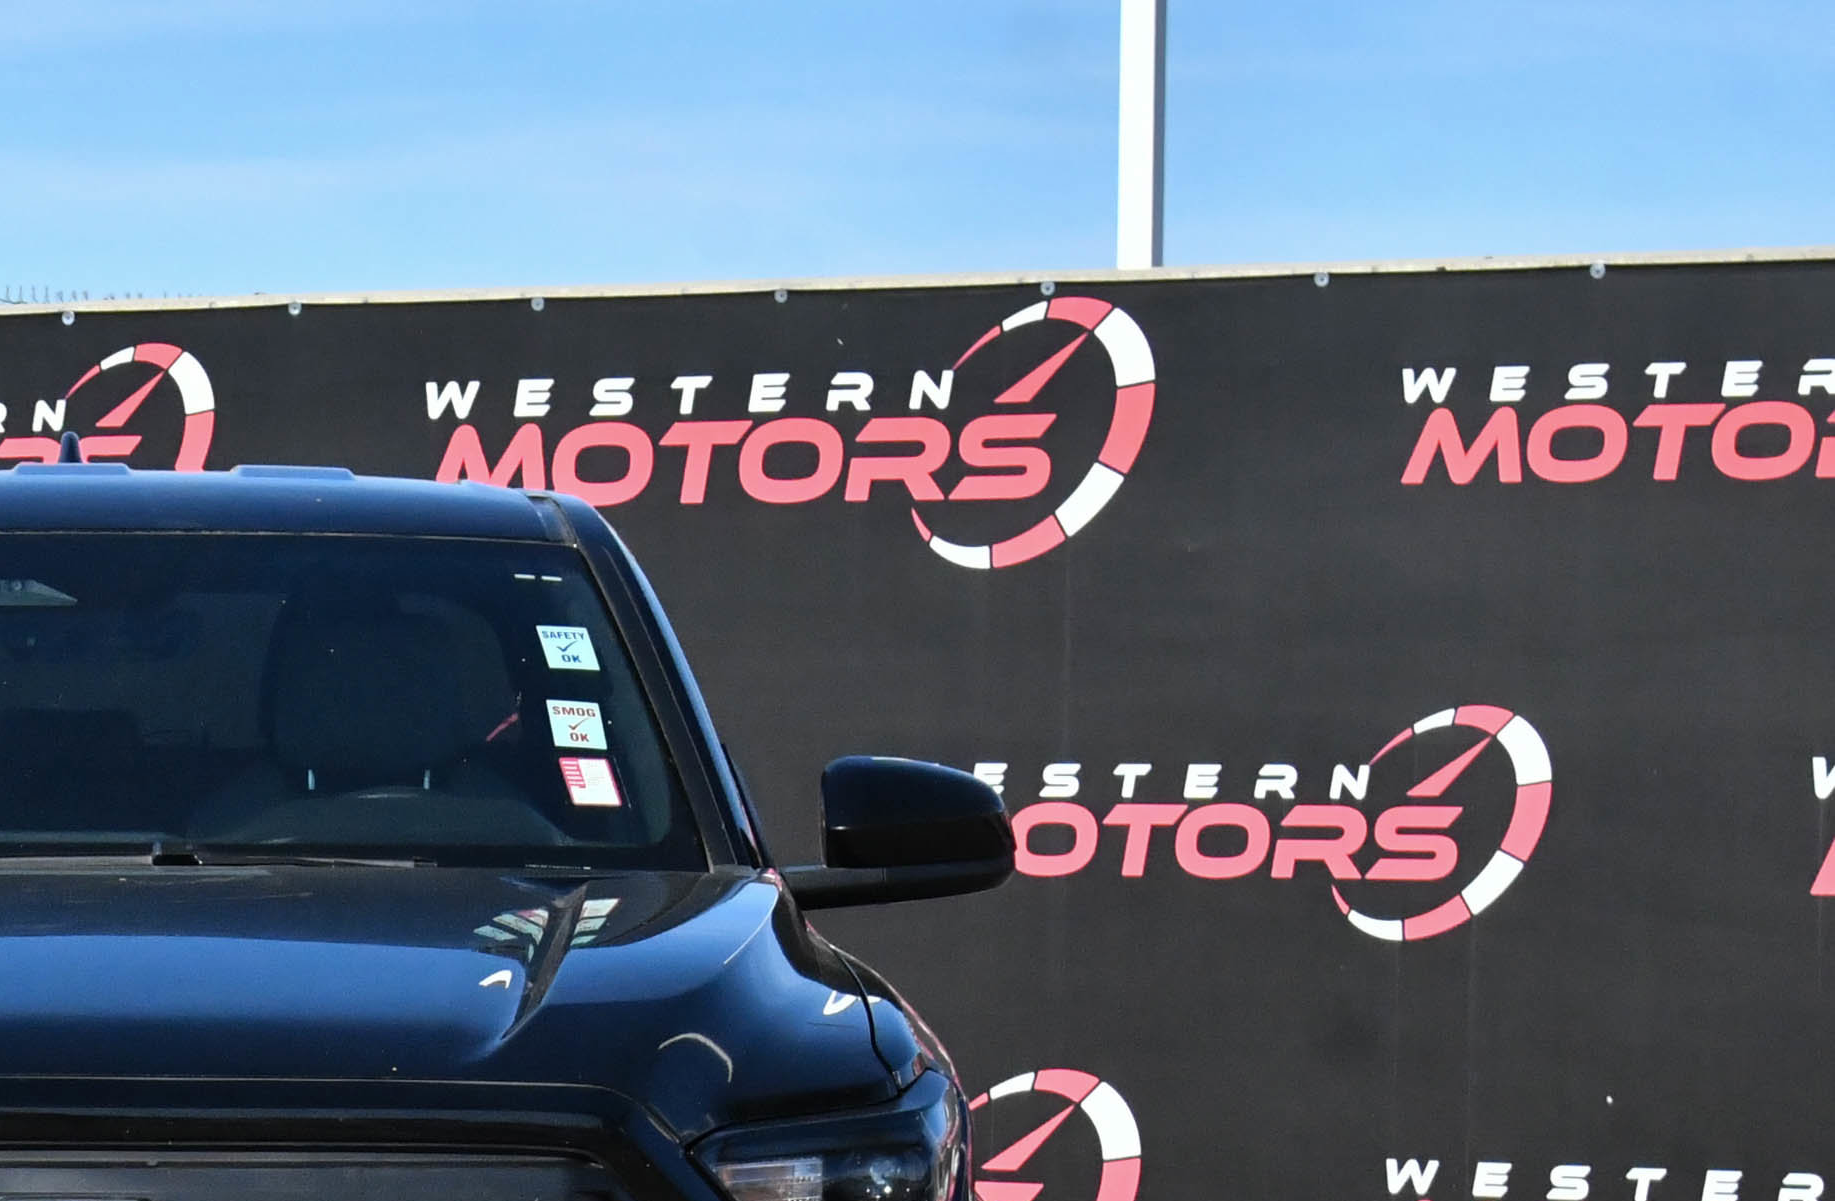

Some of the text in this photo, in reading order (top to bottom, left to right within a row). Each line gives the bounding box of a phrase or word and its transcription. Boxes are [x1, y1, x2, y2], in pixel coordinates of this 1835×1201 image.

[425, 370, 955, 420] WESTERN
[434, 413, 1057, 508] MOTORS
[1400, 401, 1835, 485] MOTO
[542, 630, 585, 641] SAFETY
[562, 654, 581, 664] OK
[552, 705, 596, 718] SMOG
[570, 732, 590, 743] OK
[973, 763, 1370, 799] ESTERN
[1011, 802, 1464, 881] OTORS
